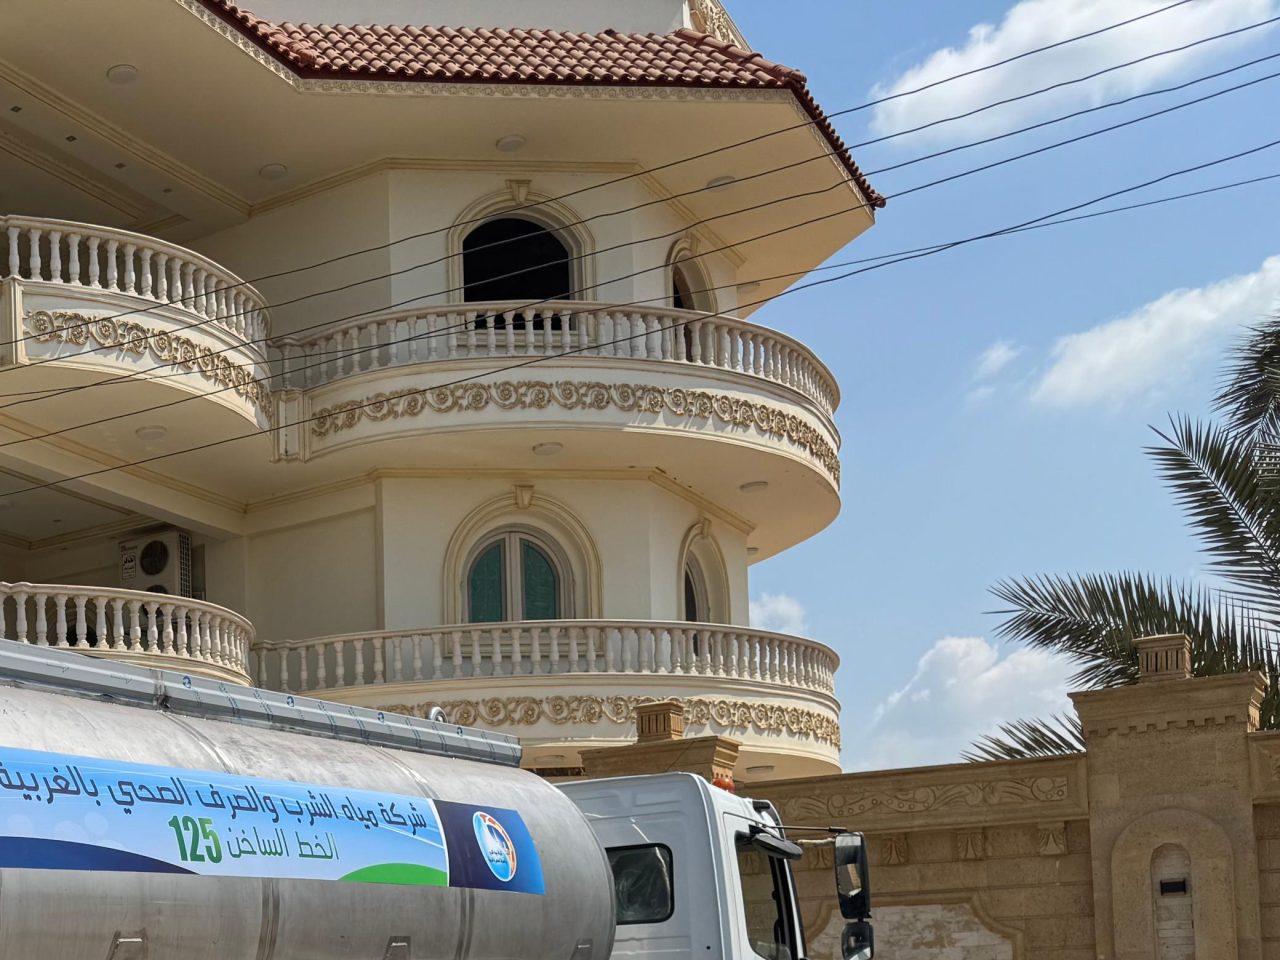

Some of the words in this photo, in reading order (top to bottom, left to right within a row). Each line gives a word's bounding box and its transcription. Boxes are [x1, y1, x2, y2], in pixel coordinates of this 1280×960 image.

[107, 777, 193, 815] الصحي
[195, 784, 278, 823] والصرف
[280, 790, 339, 826] الشرب
[341, 797, 379, 830] مياه
[378, 802, 428, 836] شركة
[167, 815, 223, 864] 125
[226, 826, 290, 859] الساخن
[294, 831, 340, 860] الخط
